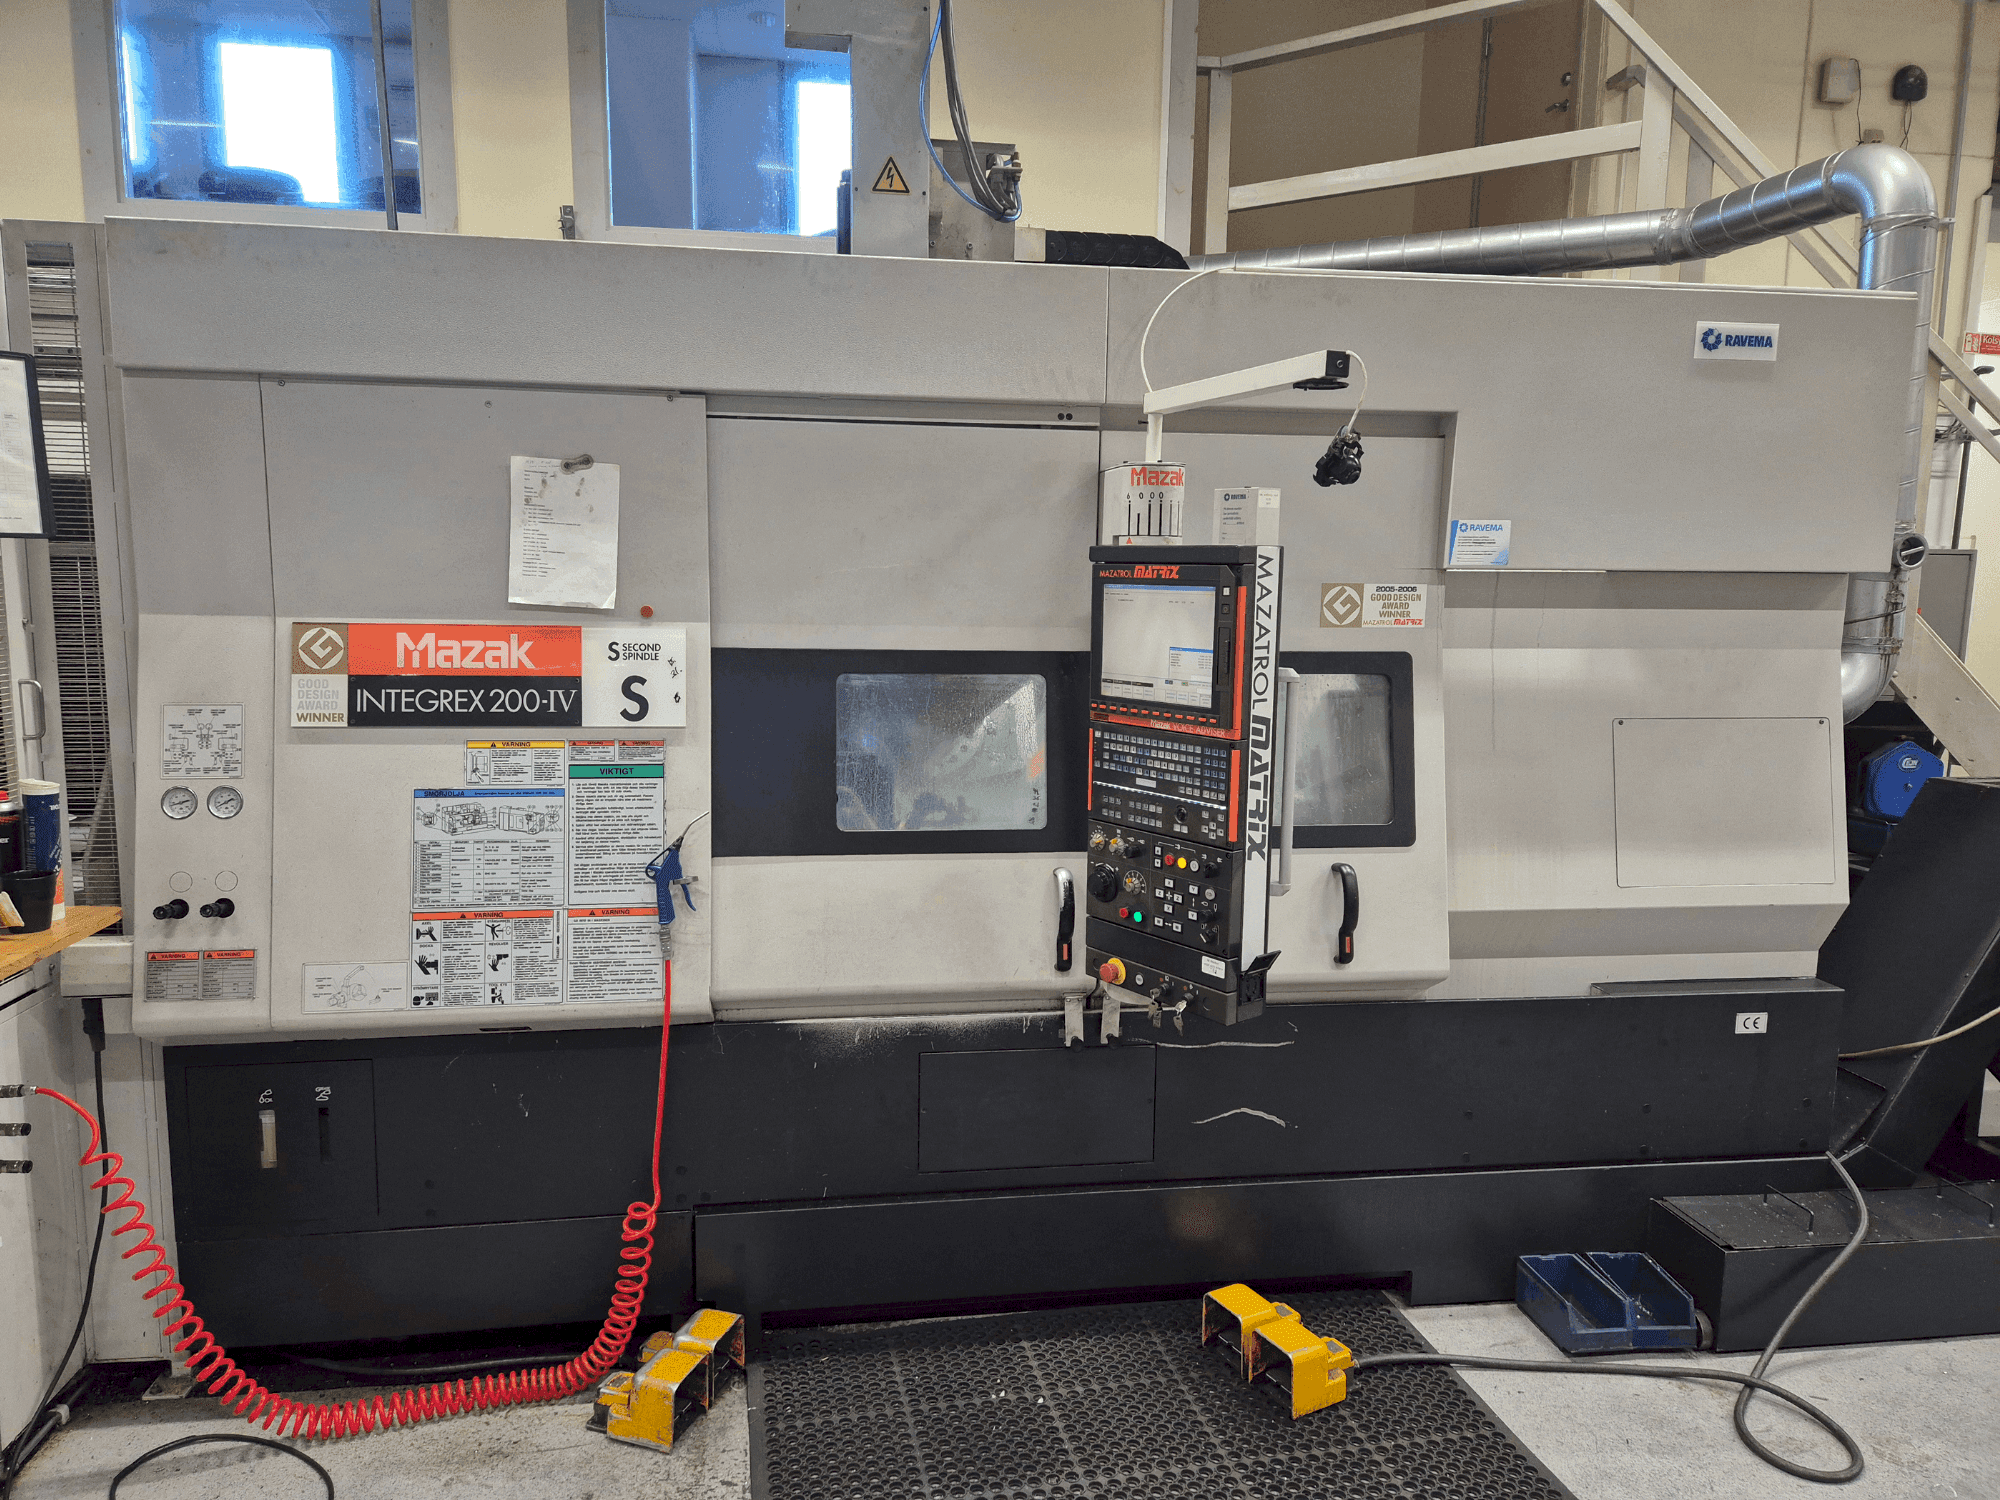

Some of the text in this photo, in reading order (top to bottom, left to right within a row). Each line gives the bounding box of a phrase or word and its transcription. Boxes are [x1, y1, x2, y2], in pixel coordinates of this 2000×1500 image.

[1725, 334, 1773, 348] RAVEMA
[1131, 467, 1184, 487] Mazak
[1100, 570, 1131, 578] MAZATROL
[1371, 593, 1392, 601] GOOD
[1379, 610, 1411, 618] WINNER
[1252, 554, 1274, 710] MAZATROL
[396, 632, 536, 669] Mazak
[607, 641, 661, 661] S SECOND
[622, 652, 659, 661] SPINDLE
[297, 678, 329, 689] GOOD
[297, 689, 339, 700] DESIGN
[356, 688, 485, 713] INTEGREX
[620, 675, 649, 722] S
[296, 700, 338, 711] AWARD
[296, 712, 345, 723] WINNER
[1150, 719, 1226, 738] Mazak VOICE ADVISER
[600, 767, 634, 776] VIKTIGT
[1743, 1016, 1760, 1030] CE
